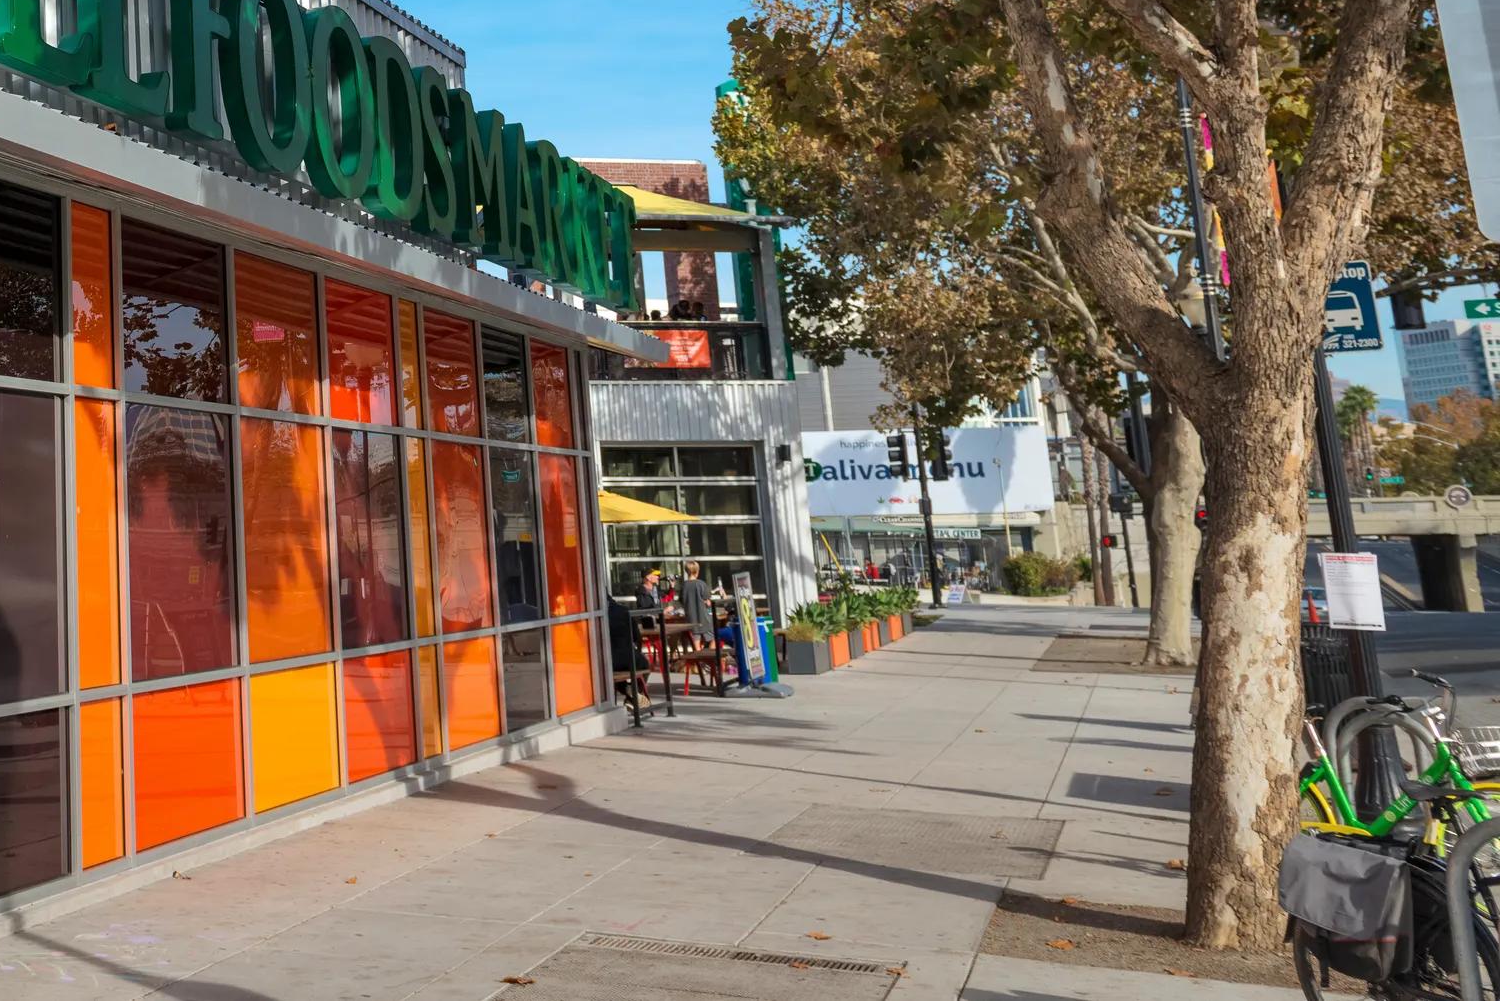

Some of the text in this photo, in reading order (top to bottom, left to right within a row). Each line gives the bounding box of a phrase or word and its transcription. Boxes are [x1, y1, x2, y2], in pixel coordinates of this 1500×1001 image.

[1337, 266, 1366, 280] top
[1342, 338, 1379, 348] 321-2300
[821, 459, 892, 481] aliva
